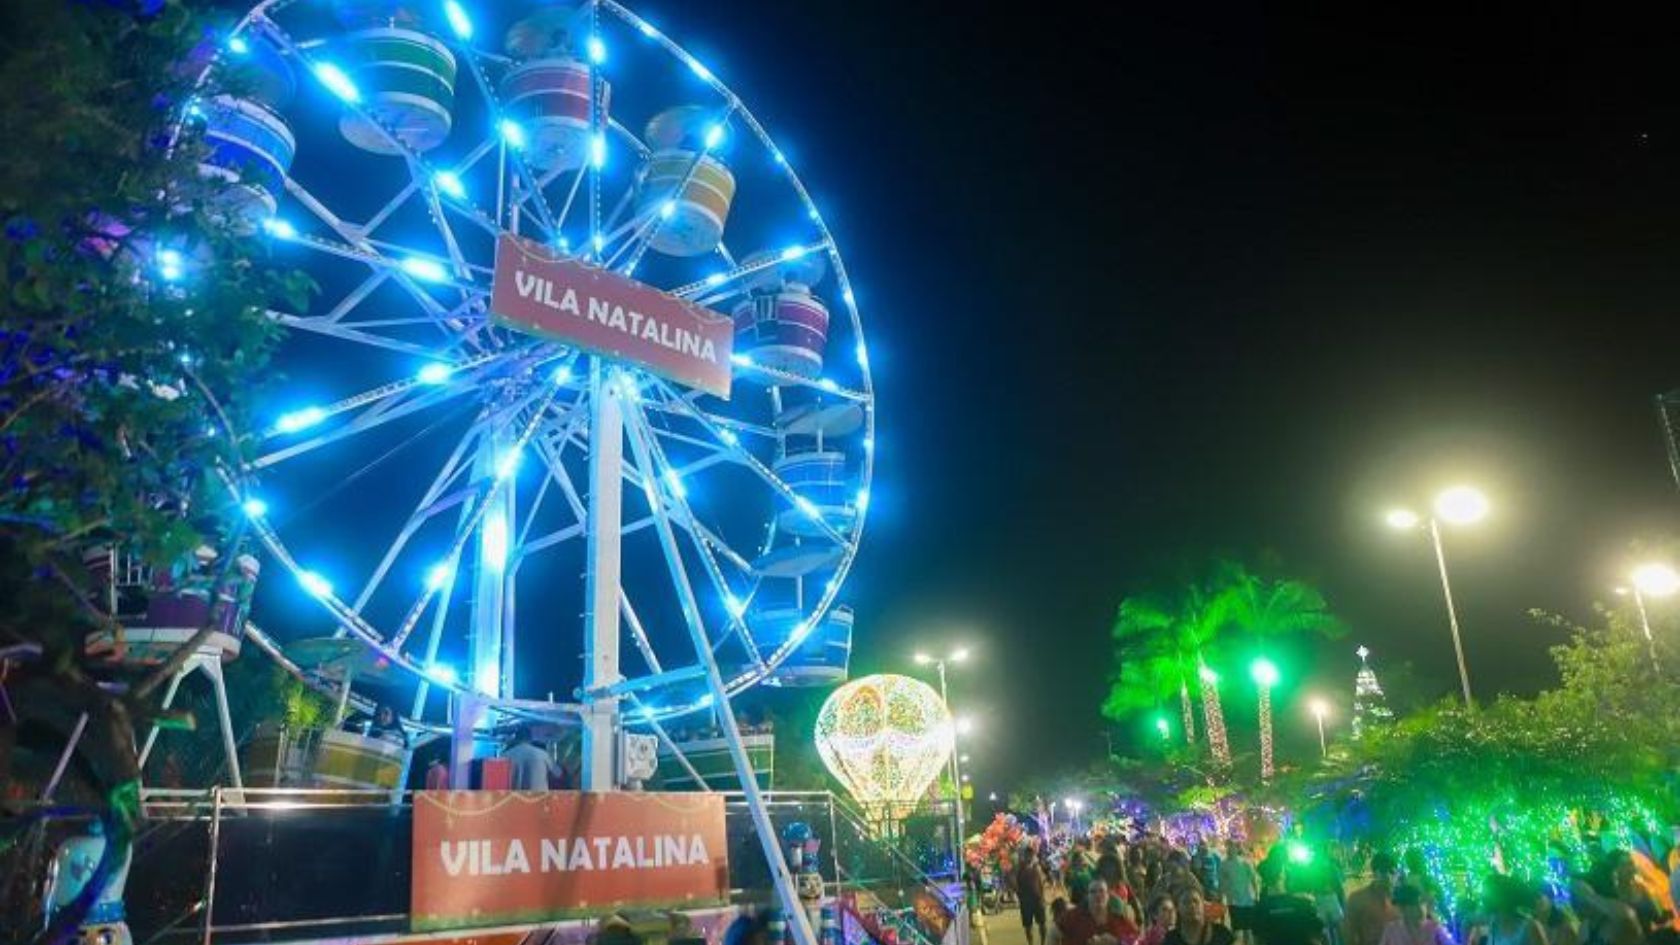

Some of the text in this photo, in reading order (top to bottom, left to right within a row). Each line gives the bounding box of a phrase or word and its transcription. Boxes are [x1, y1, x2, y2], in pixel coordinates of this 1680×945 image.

[515, 271, 717, 363] VILA NATALINA
[440, 834, 710, 876] VILA NATALINA
